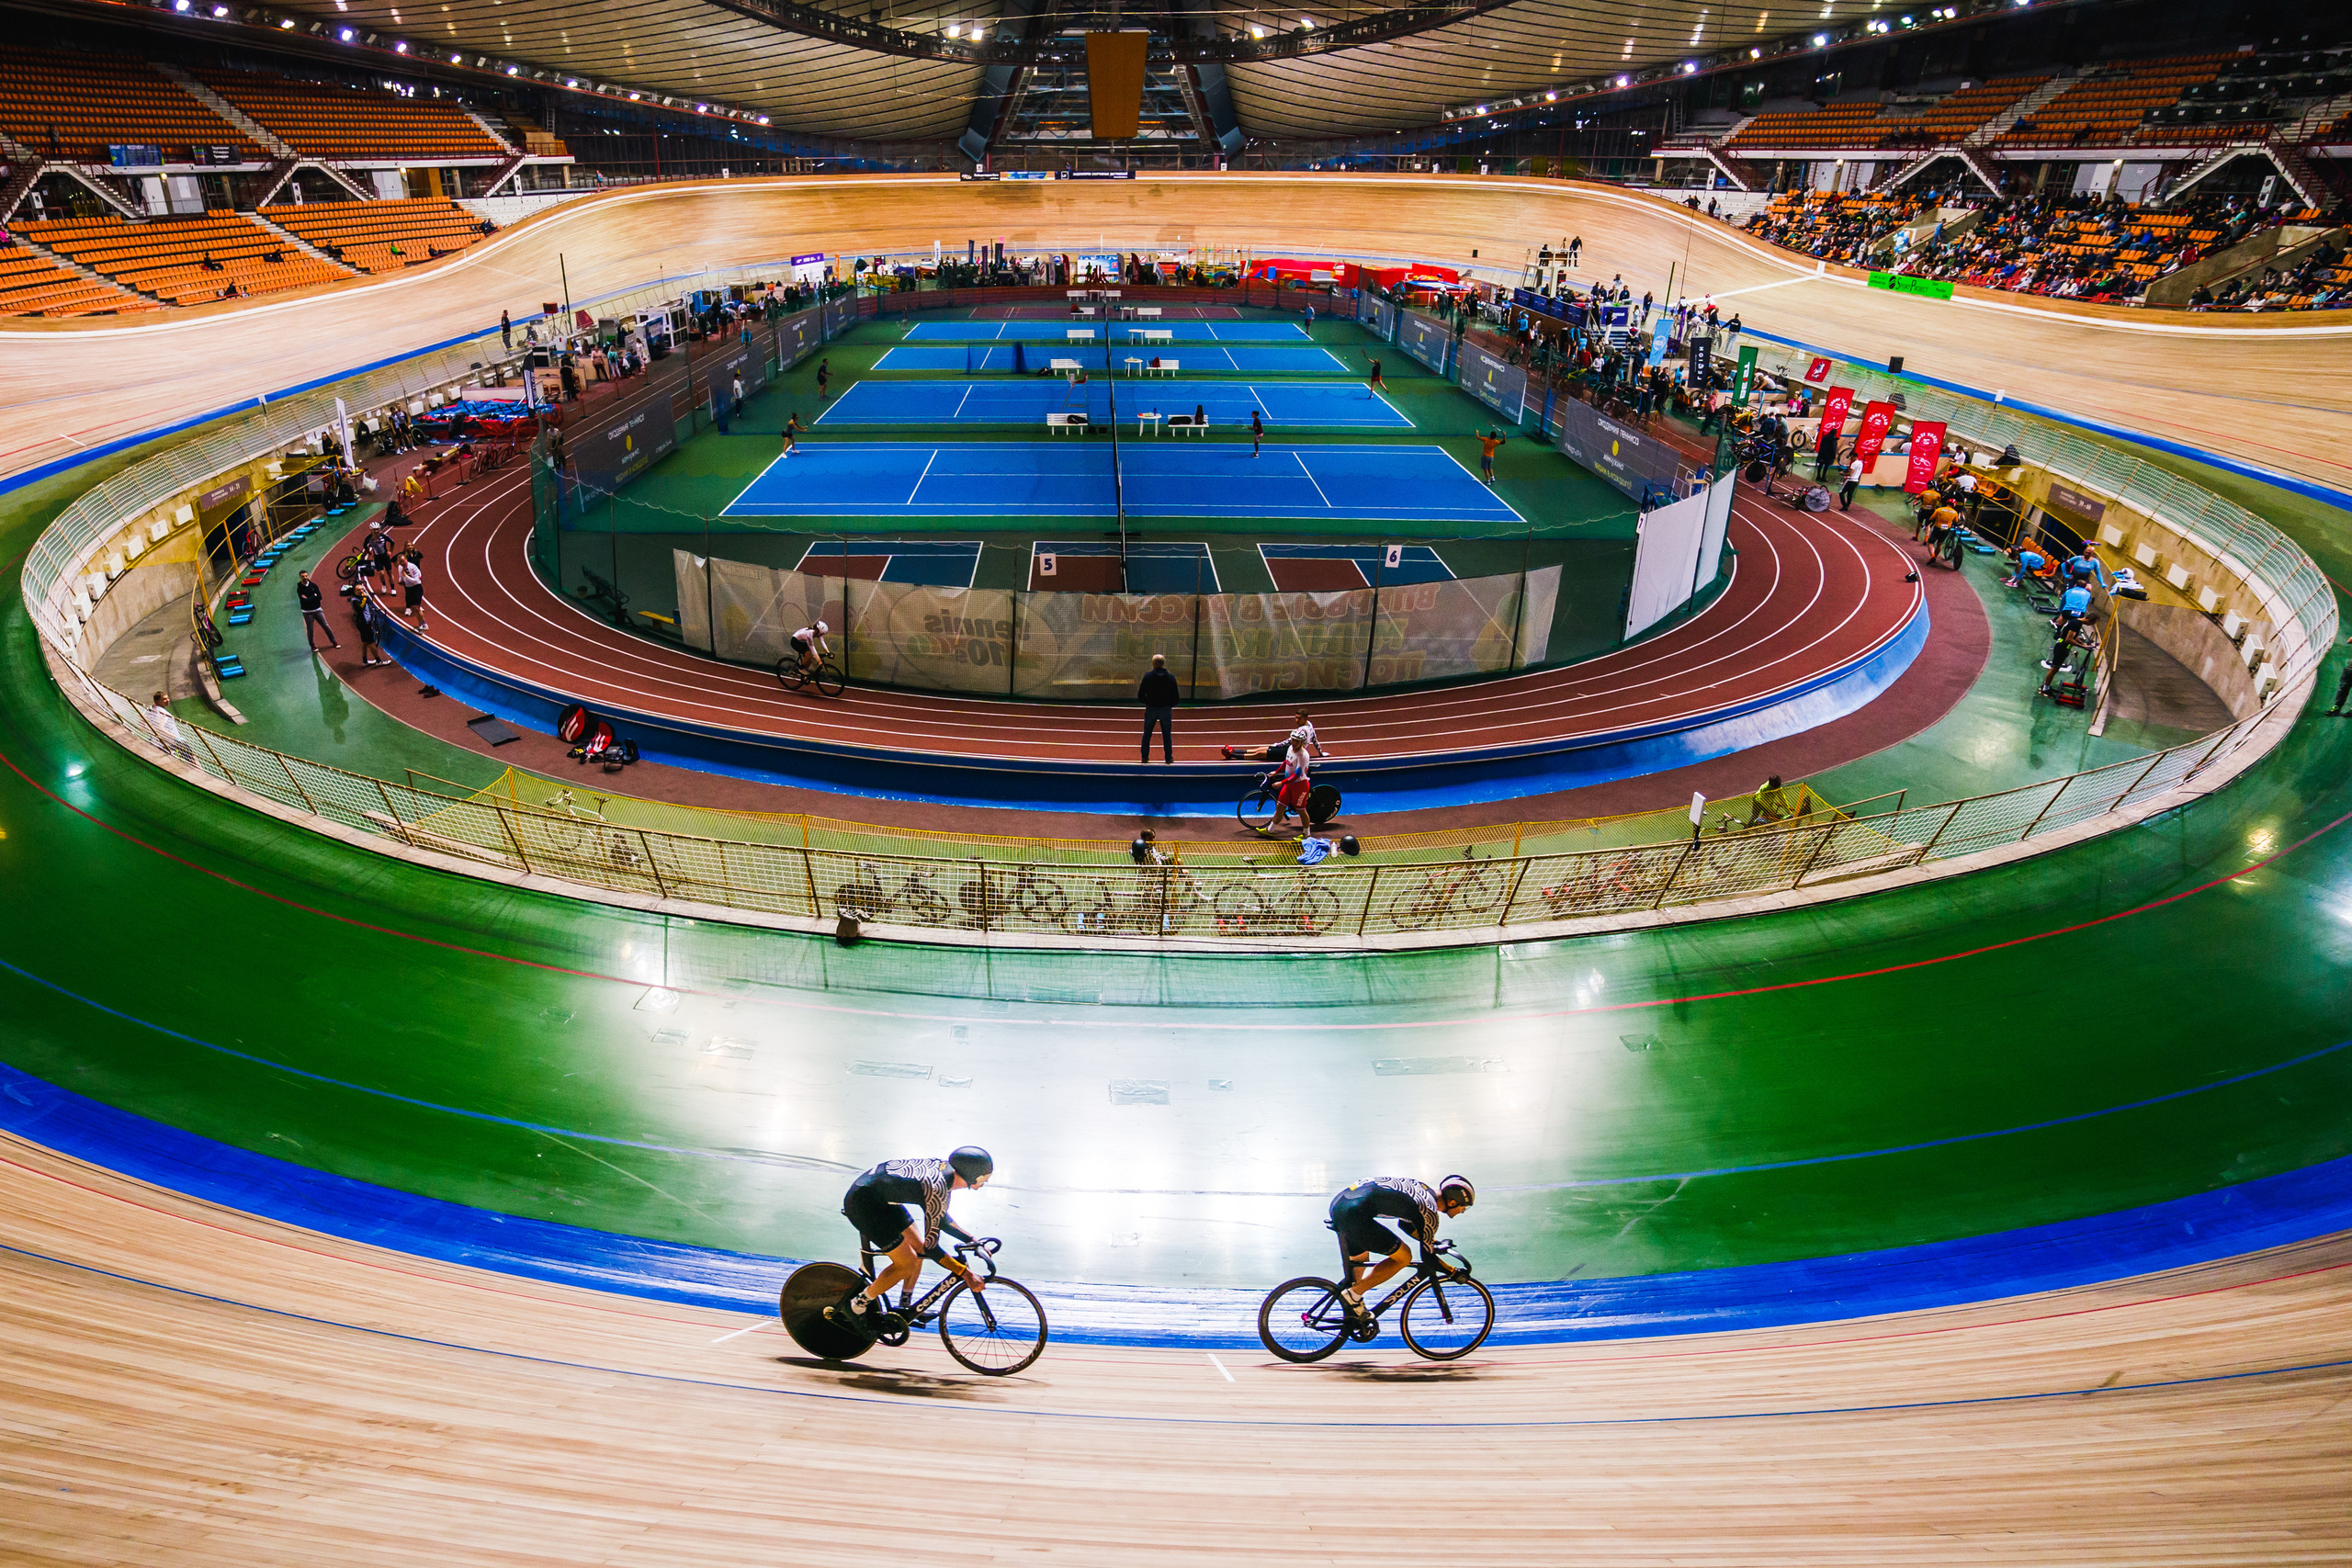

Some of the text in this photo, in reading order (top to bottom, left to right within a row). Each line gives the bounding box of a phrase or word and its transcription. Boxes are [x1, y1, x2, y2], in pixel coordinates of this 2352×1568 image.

[1389, 550, 1397, 563] 6
[1044, 558, 1053, 571] 5
[1383, 1276, 1421, 1305] DOLAN
